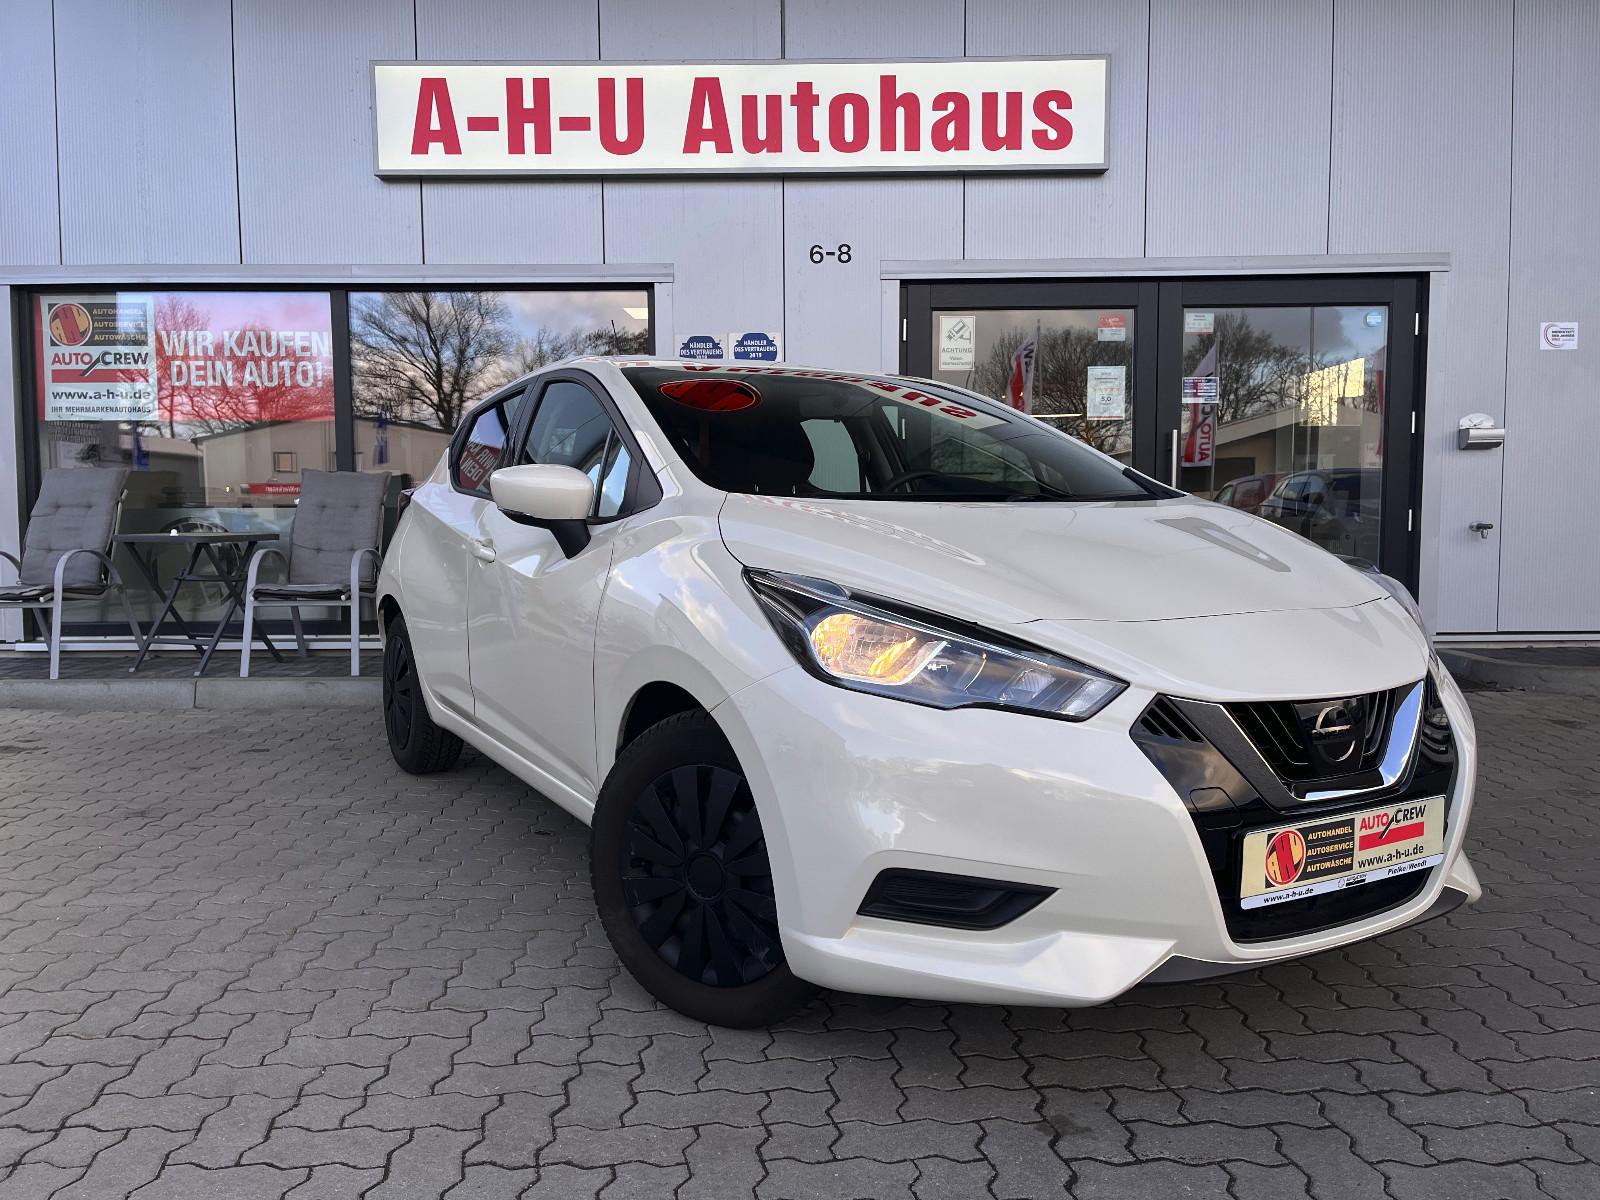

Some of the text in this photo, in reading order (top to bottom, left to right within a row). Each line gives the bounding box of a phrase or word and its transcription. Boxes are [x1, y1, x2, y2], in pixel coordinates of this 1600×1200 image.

[411, 74, 1074, 156] A-H-U Autohaus
[808, 243, 853, 265] 6-8
[160, 330, 330, 357] WIR KAUFEN
[689, 341, 713, 349] HÄNDLER
[743, 338, 767, 346] HÄNDLER
[170, 360, 323, 388] DEIN AUTO!
[51, 389, 151, 400] www.a-h-u.de
[1307, 825, 1353, 840] AUTOHANDEL
[1306, 841, 1354, 857] AUTOSERVICE
[1358, 843, 1424, 868] www.a-h-u.de
[1306, 857, 1353, 873] AUTOWÄSCHE
[1263, 887, 1315, 904] www.a-h-u.de
